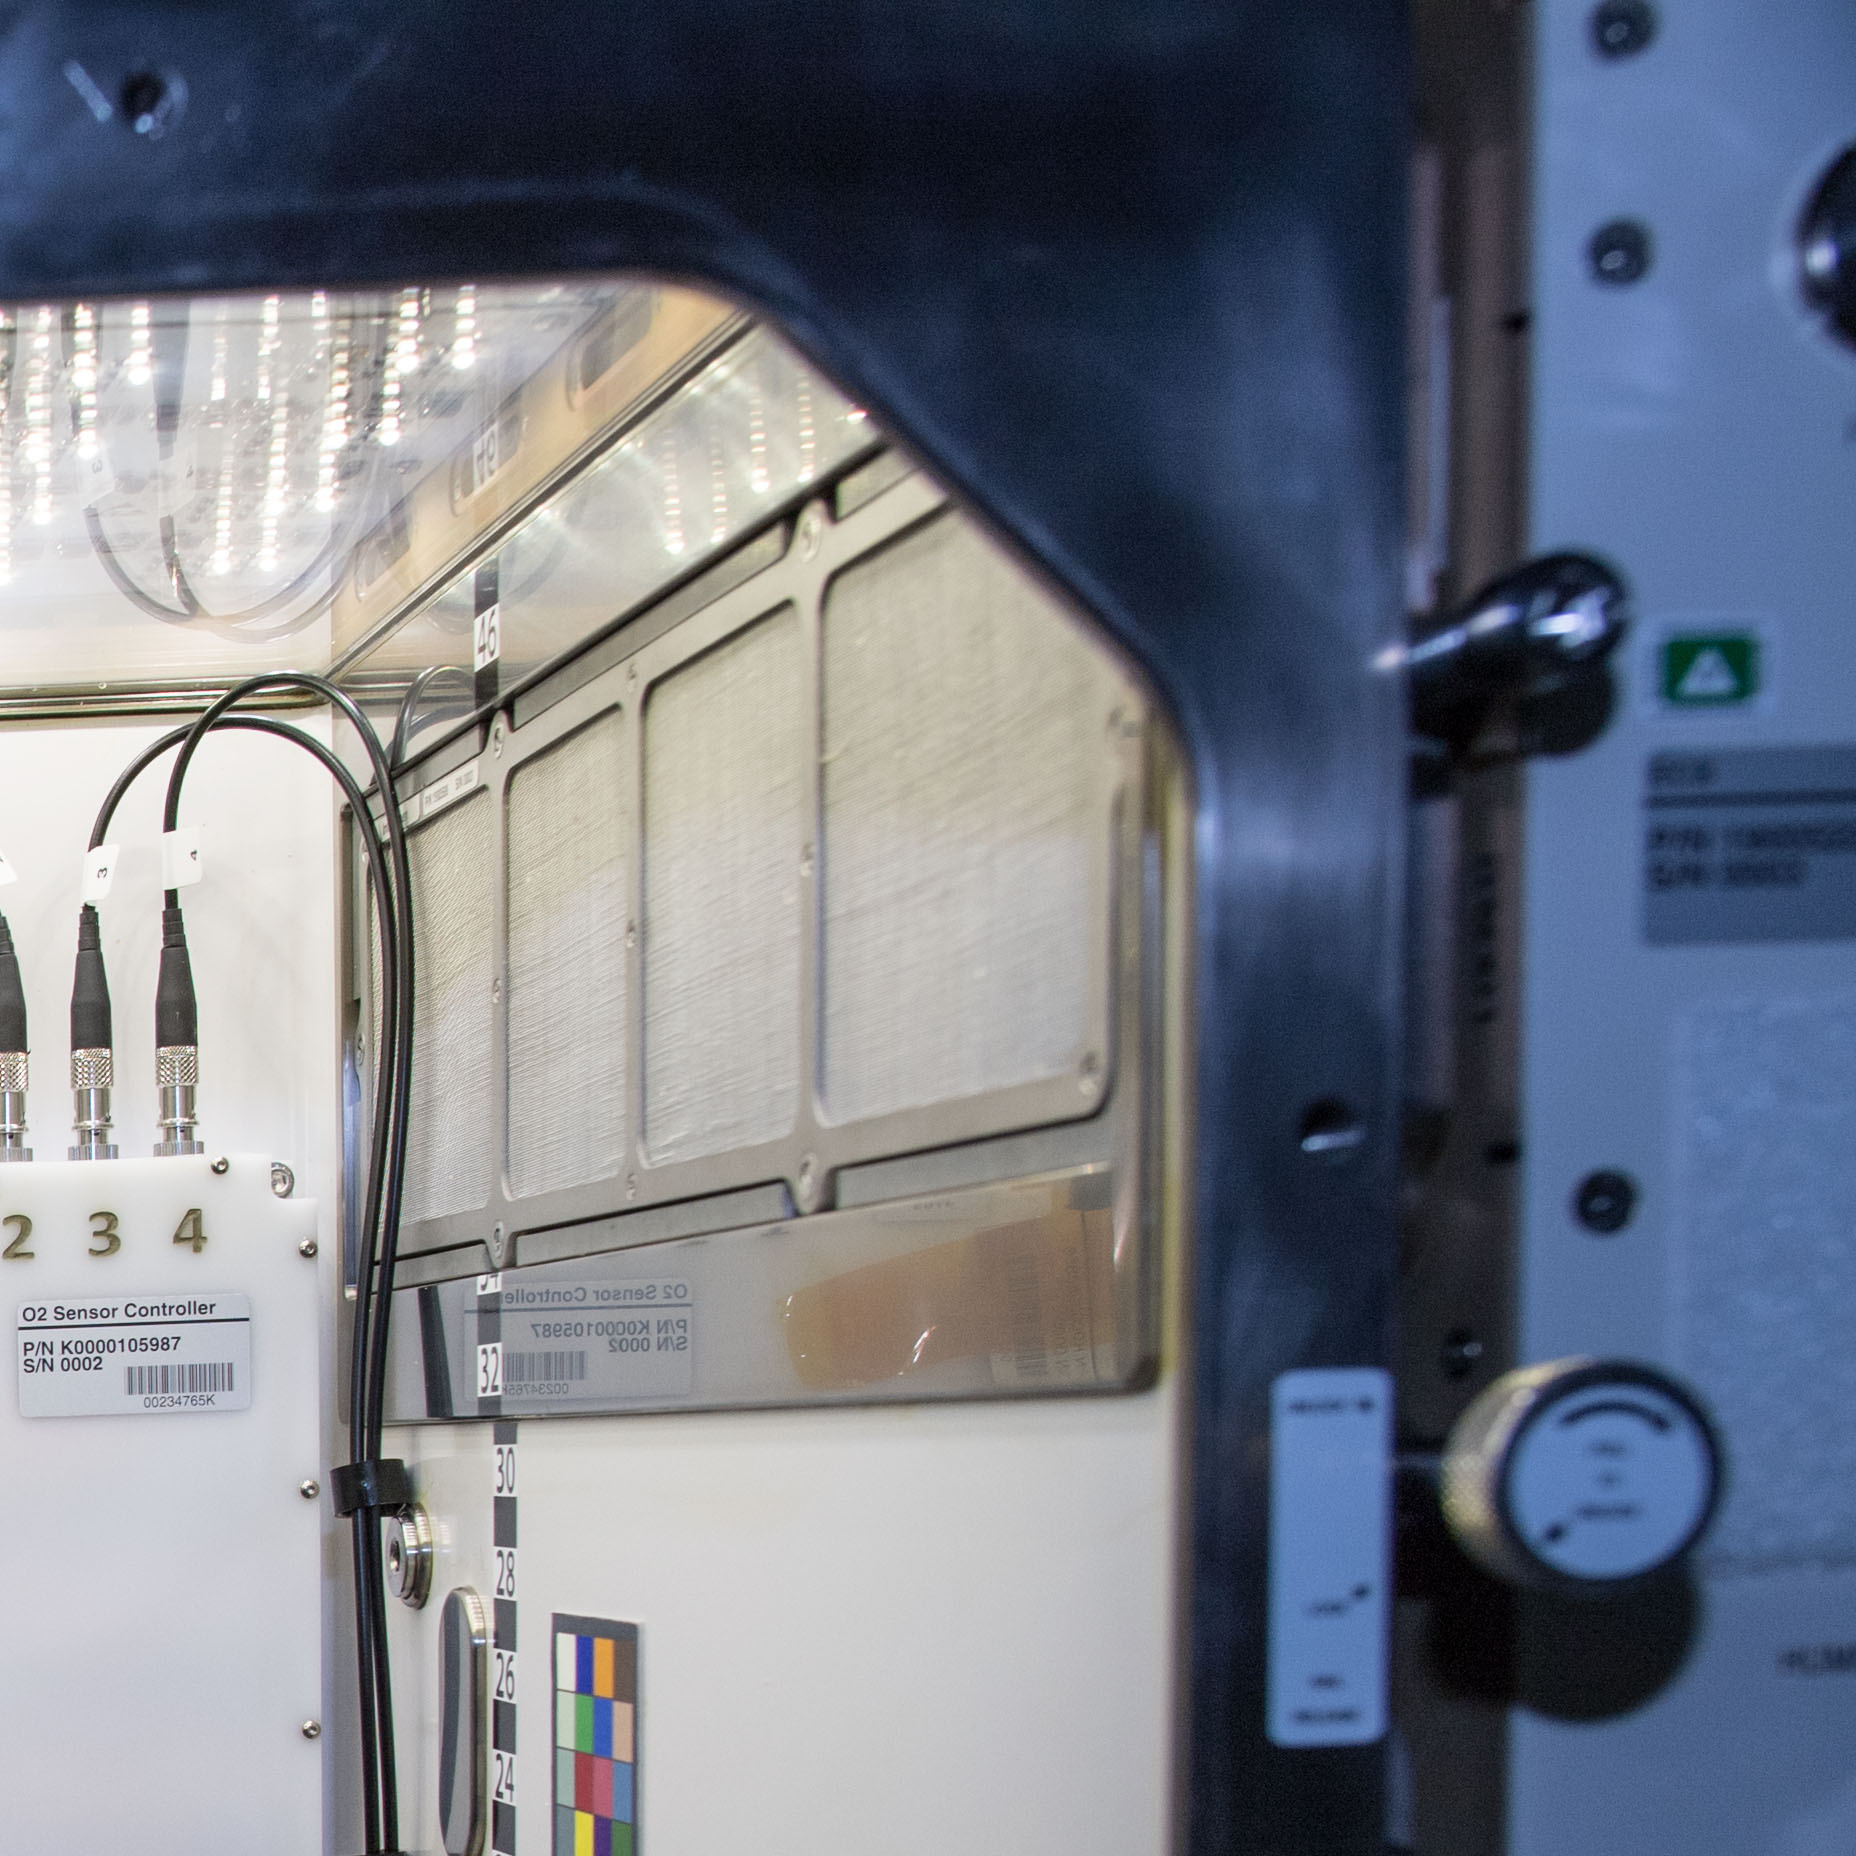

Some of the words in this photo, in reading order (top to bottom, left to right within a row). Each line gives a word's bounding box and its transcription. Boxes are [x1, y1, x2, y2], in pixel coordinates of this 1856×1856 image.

[476, 608, 497, 665] 46
[1, 1214, 36, 1261] 2
[88, 1211, 122, 1257] 3
[172, 1207, 209, 1254] 4
[22, 1306, 48, 1322] O2
[53, 1304, 120, 1321] Sensor
[124, 1300, 217, 1319] Controller
[23, 1341, 54, 1357] P/N
[60, 1336, 182, 1356] K0000105987
[23, 1357, 55, 1374] S/N
[60, 1355, 103, 1373] 0002
[480, 1346, 499, 1394] 32
[143, 1393, 216, 1409] 00234765K
[496, 1446, 516, 1495] 30
[496, 1549, 517, 1598] 28
[495, 1651, 515, 1700] 26
[495, 1752, 515, 1803] 24
